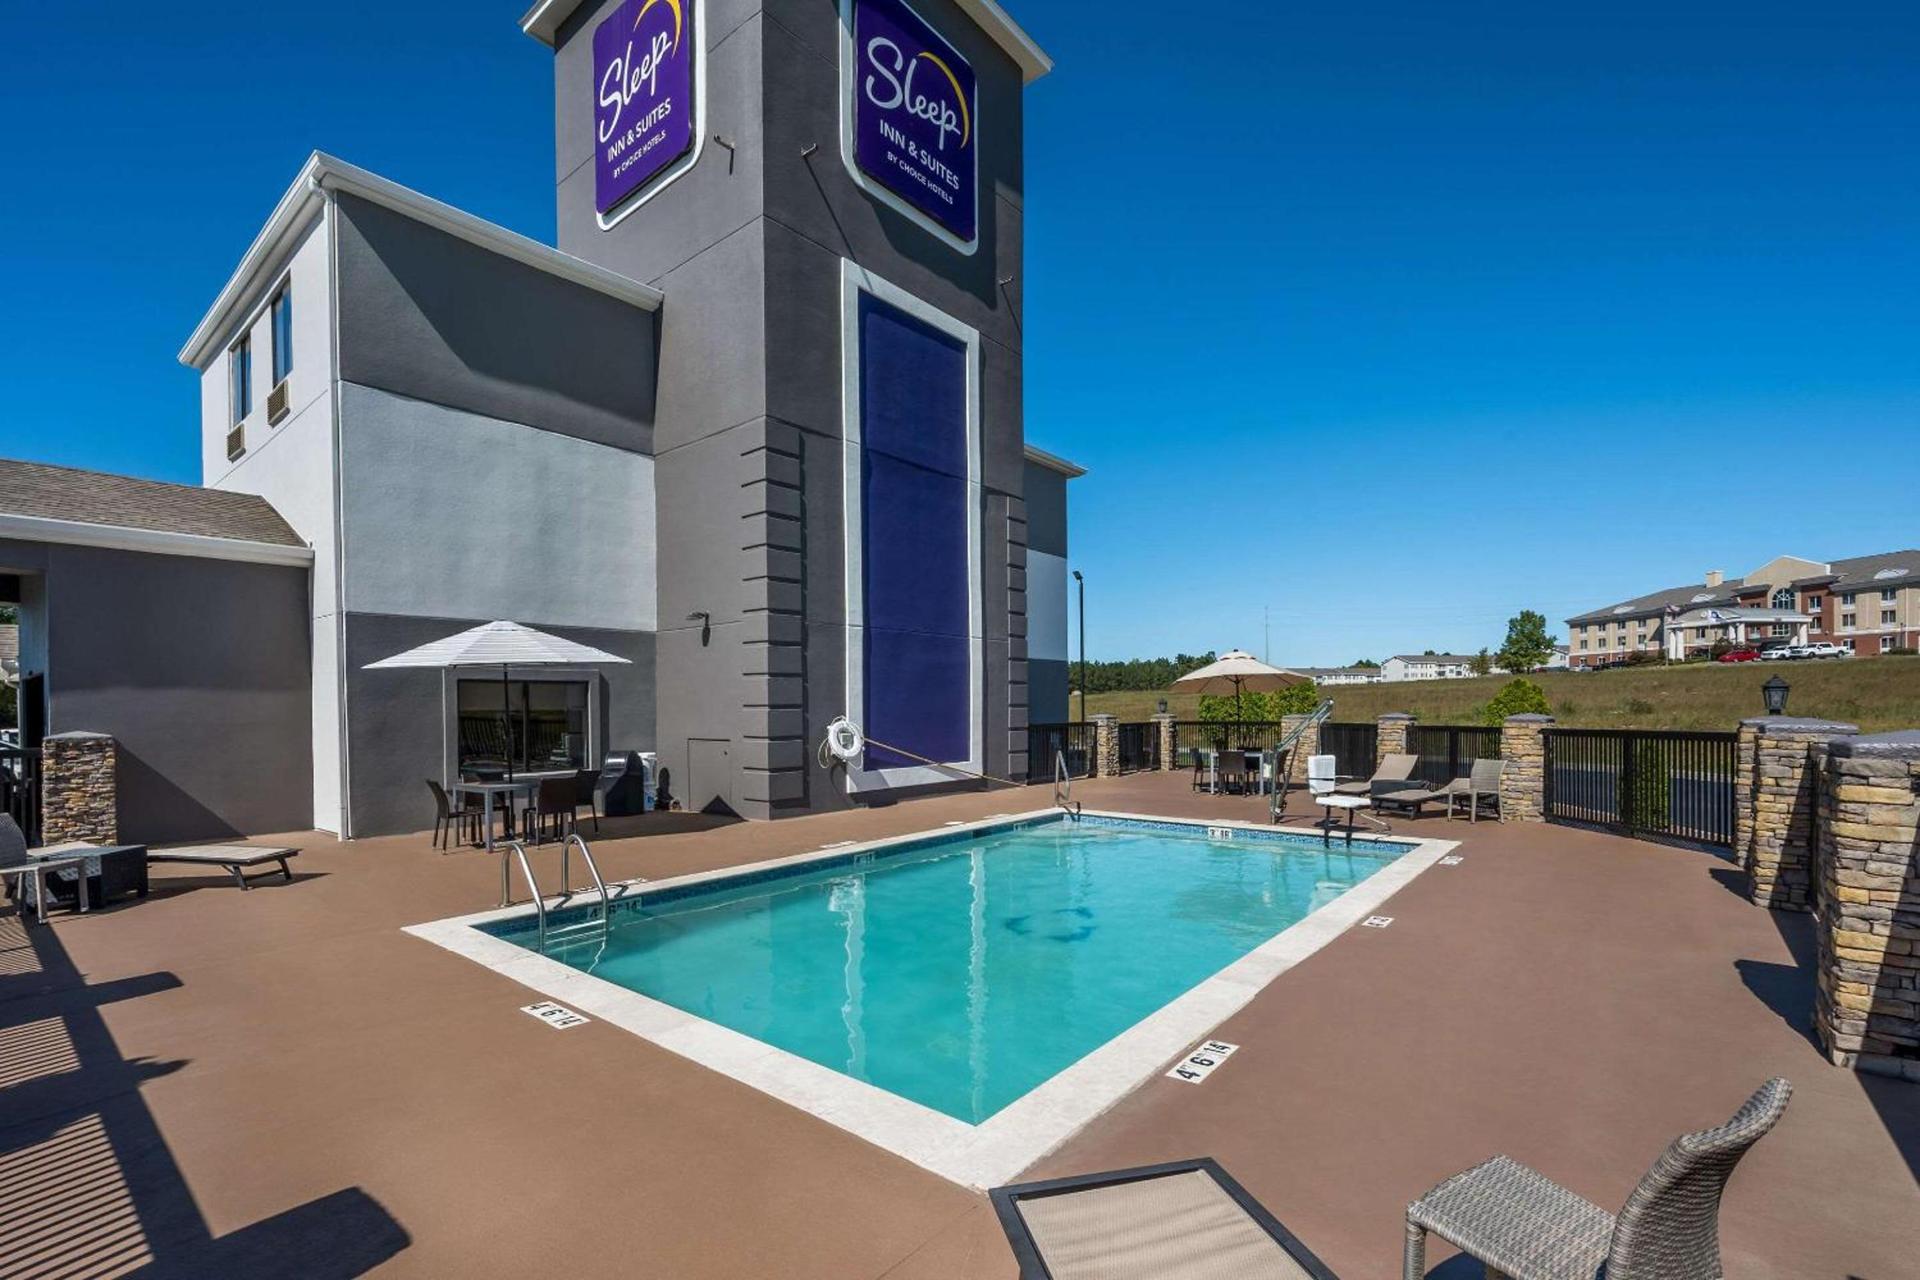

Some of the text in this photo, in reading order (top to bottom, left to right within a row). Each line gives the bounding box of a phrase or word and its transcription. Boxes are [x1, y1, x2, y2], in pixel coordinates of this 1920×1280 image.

[600, 31, 672, 143] Sleep
[866, 37, 961, 151] Sleep
[607, 97, 672, 163] INN & SUITES
[613, 129, 666, 179] BY CHOICE HOTELS
[880, 119, 959, 190] INN & SUITES
[887, 151, 953, 205] BY CHOICE HOTELS
